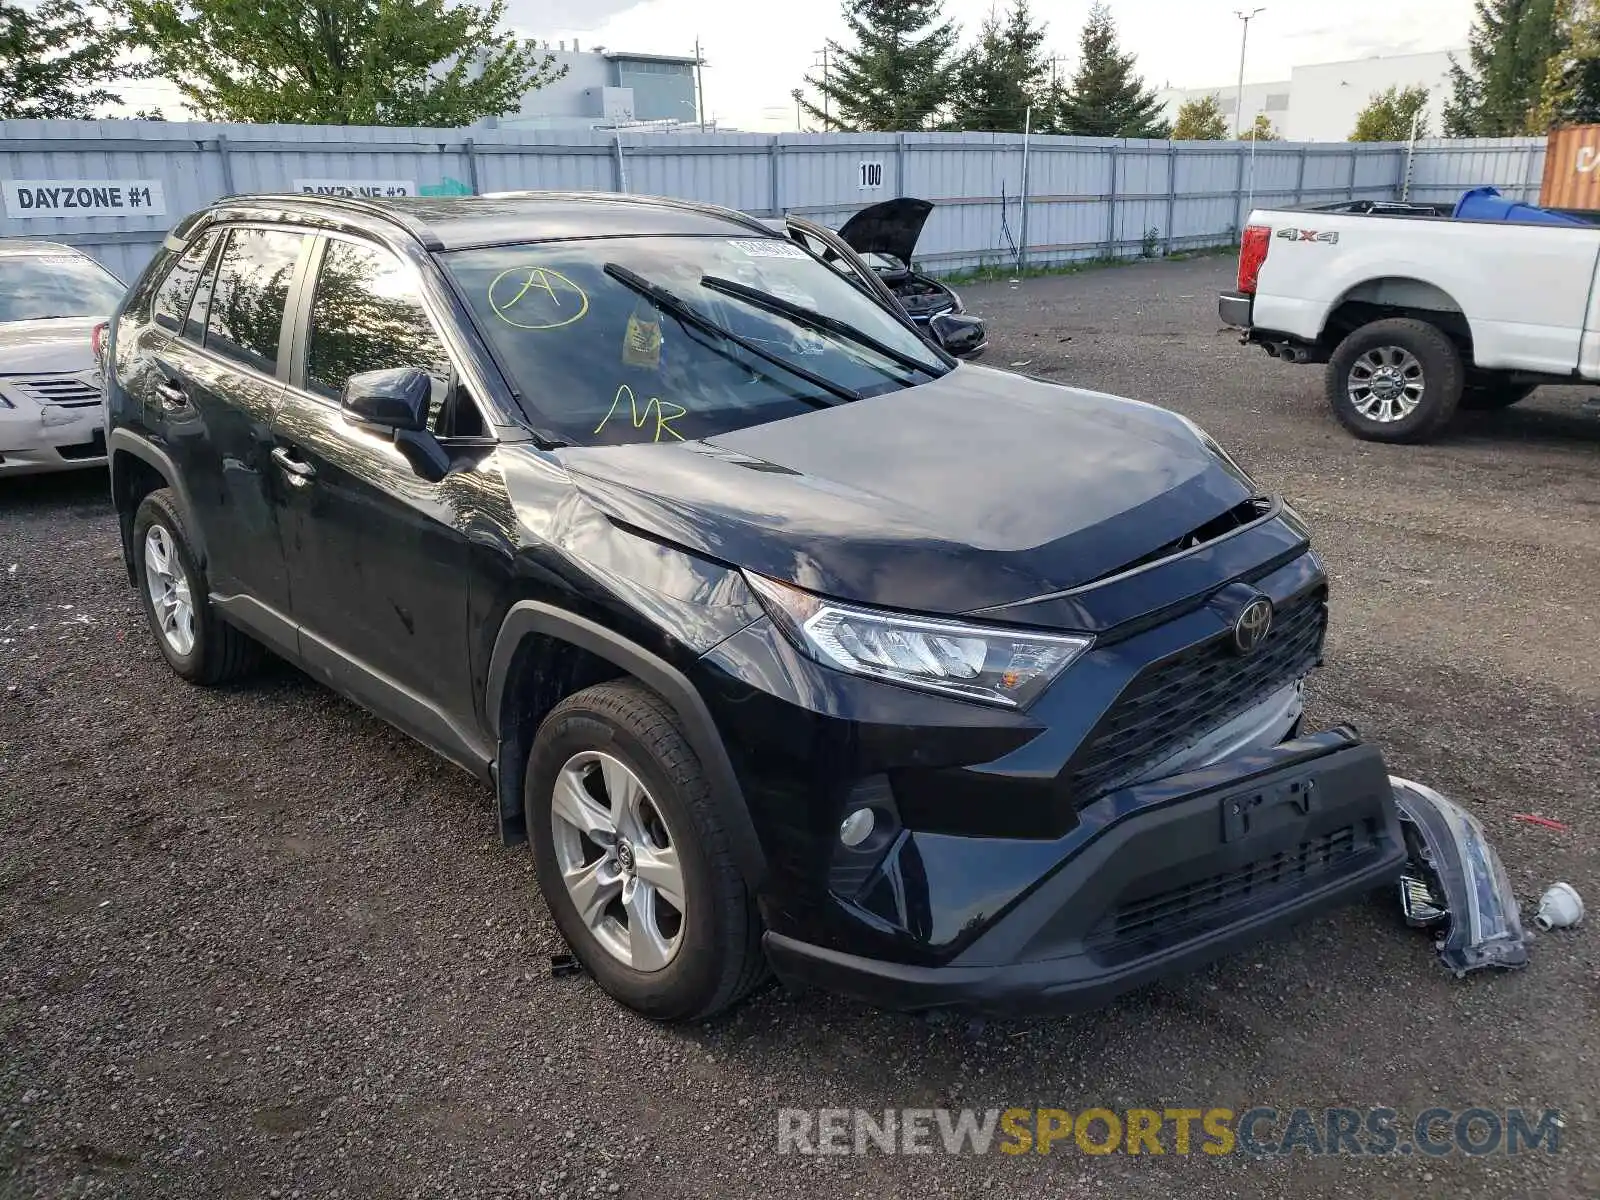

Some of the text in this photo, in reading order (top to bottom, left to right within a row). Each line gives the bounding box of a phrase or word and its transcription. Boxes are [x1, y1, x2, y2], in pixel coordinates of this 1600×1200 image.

[861, 164, 881, 186] 100
[17, 187, 152, 209] DAYZONE #1
[303, 186, 381, 197] YZNE
